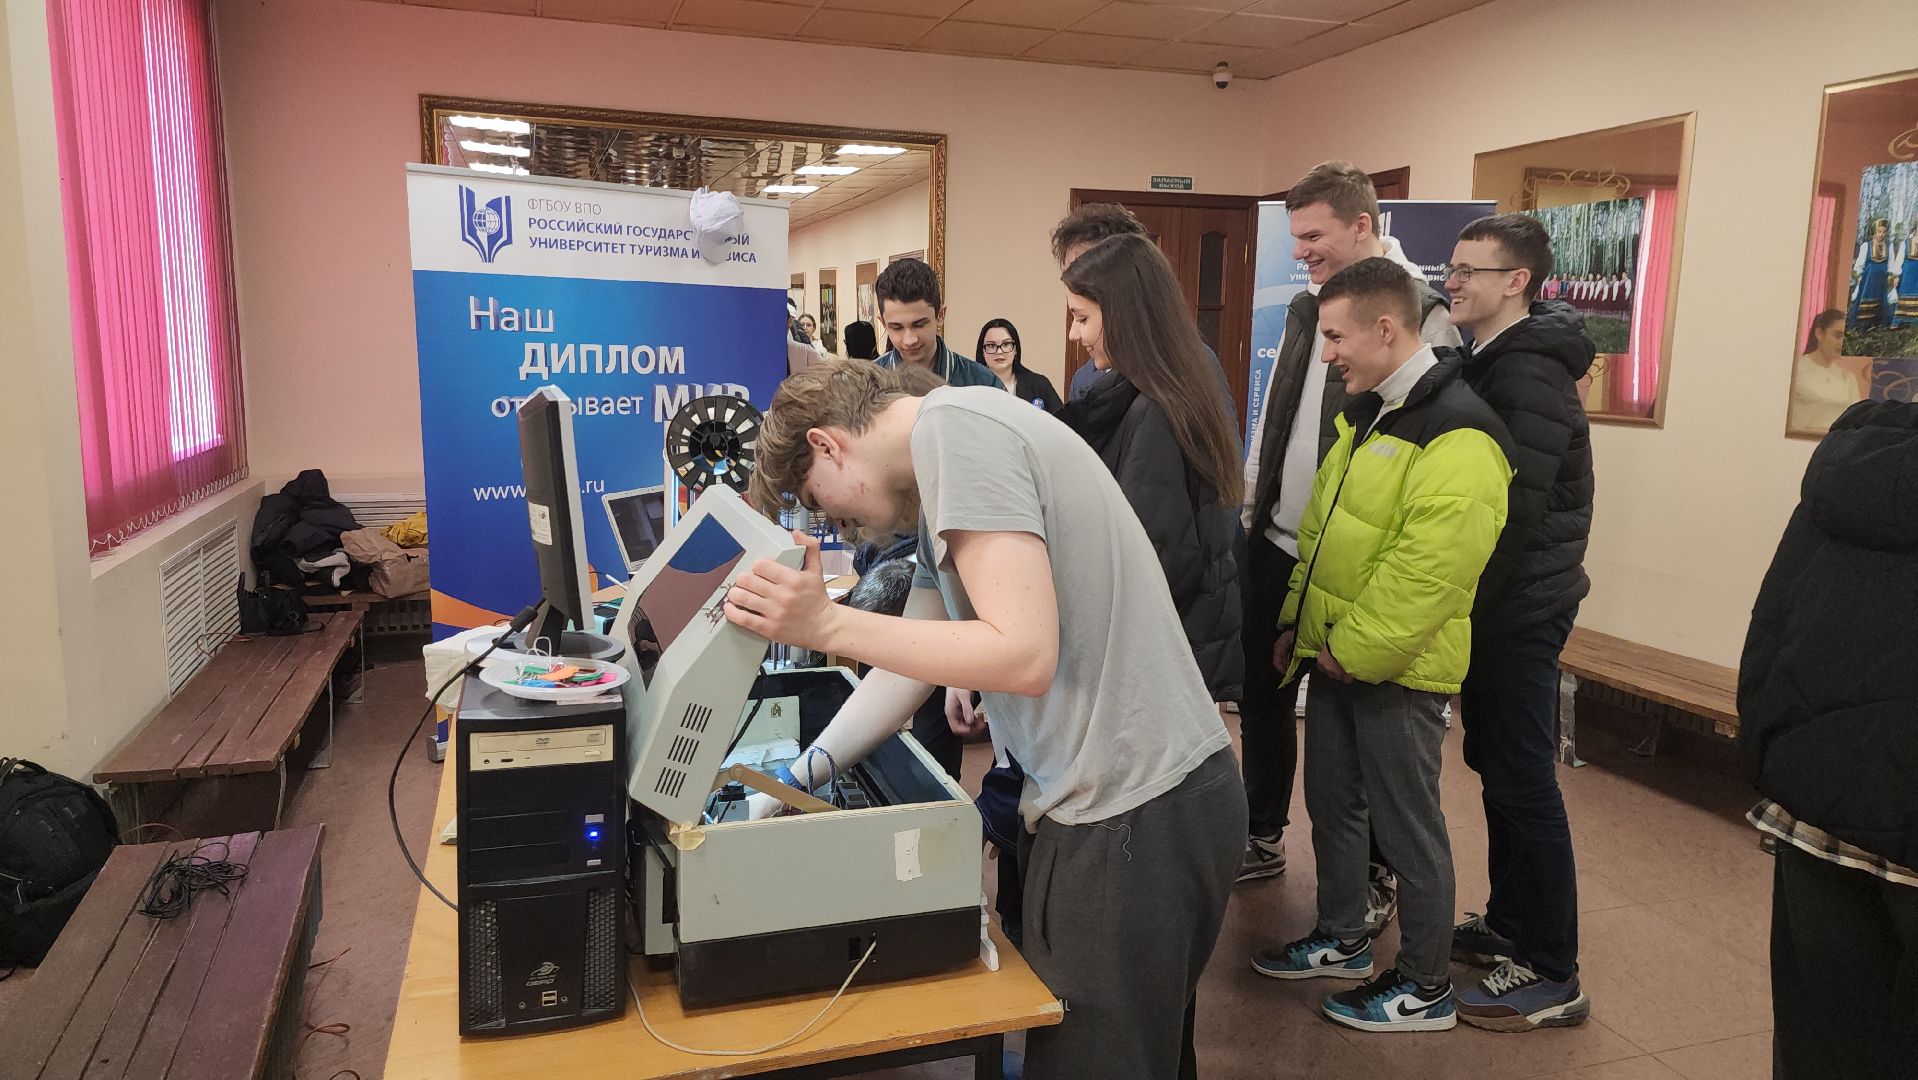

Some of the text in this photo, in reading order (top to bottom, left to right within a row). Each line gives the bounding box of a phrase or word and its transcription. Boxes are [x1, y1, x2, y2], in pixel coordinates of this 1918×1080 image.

[527, 198, 602, 215] ФГБОУ ВПО
[528, 217, 750, 246] РОССИЙСКИЙ ГОСУДАРСЫЙ
[529, 236, 626, 255] УНИВЕРСИТЕТ
[629, 243, 689, 259] ТУРИЗМА
[691, 248, 701, 260] И
[469, 295, 555, 332] Наш
[491, 395, 644, 418] отывает
